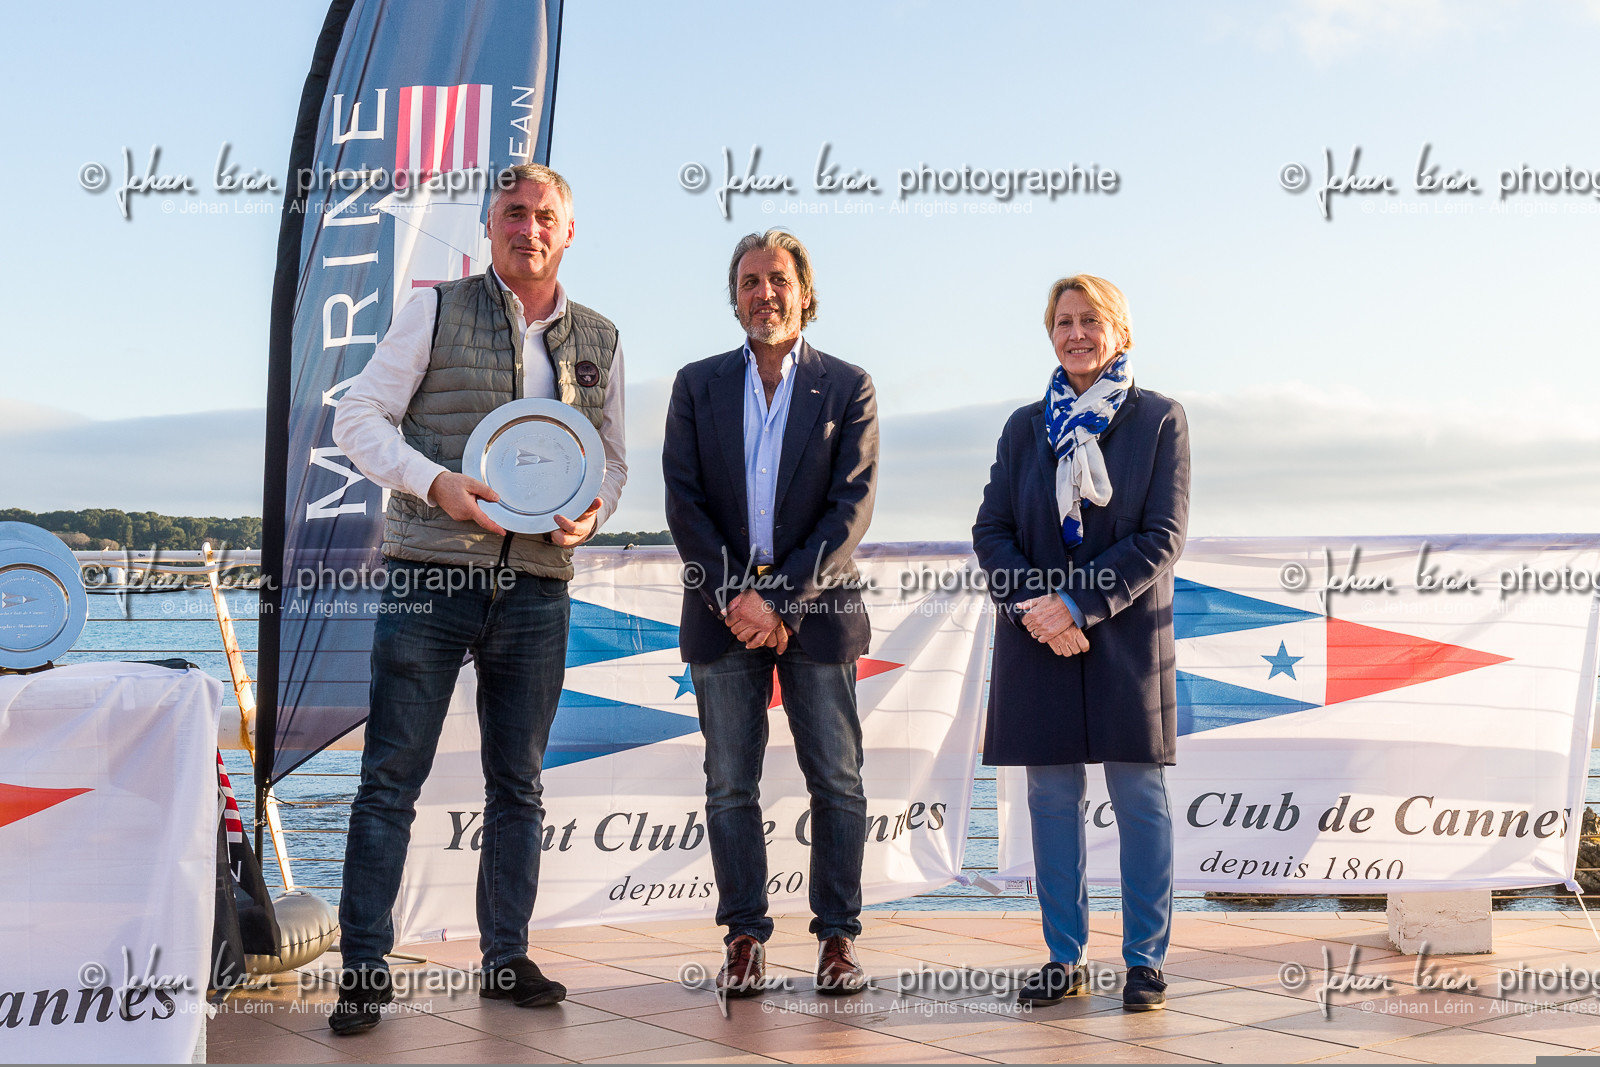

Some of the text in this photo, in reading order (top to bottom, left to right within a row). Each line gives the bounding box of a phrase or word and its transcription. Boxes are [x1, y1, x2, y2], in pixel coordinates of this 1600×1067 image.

[508, 85, 535, 168] EAN
[593, 811, 705, 852] Club
[1186, 792, 1571, 839] Club de Cannes
[1199, 850, 1404, 880] depuis 1860
[609, 871, 803, 906] depuis 60
